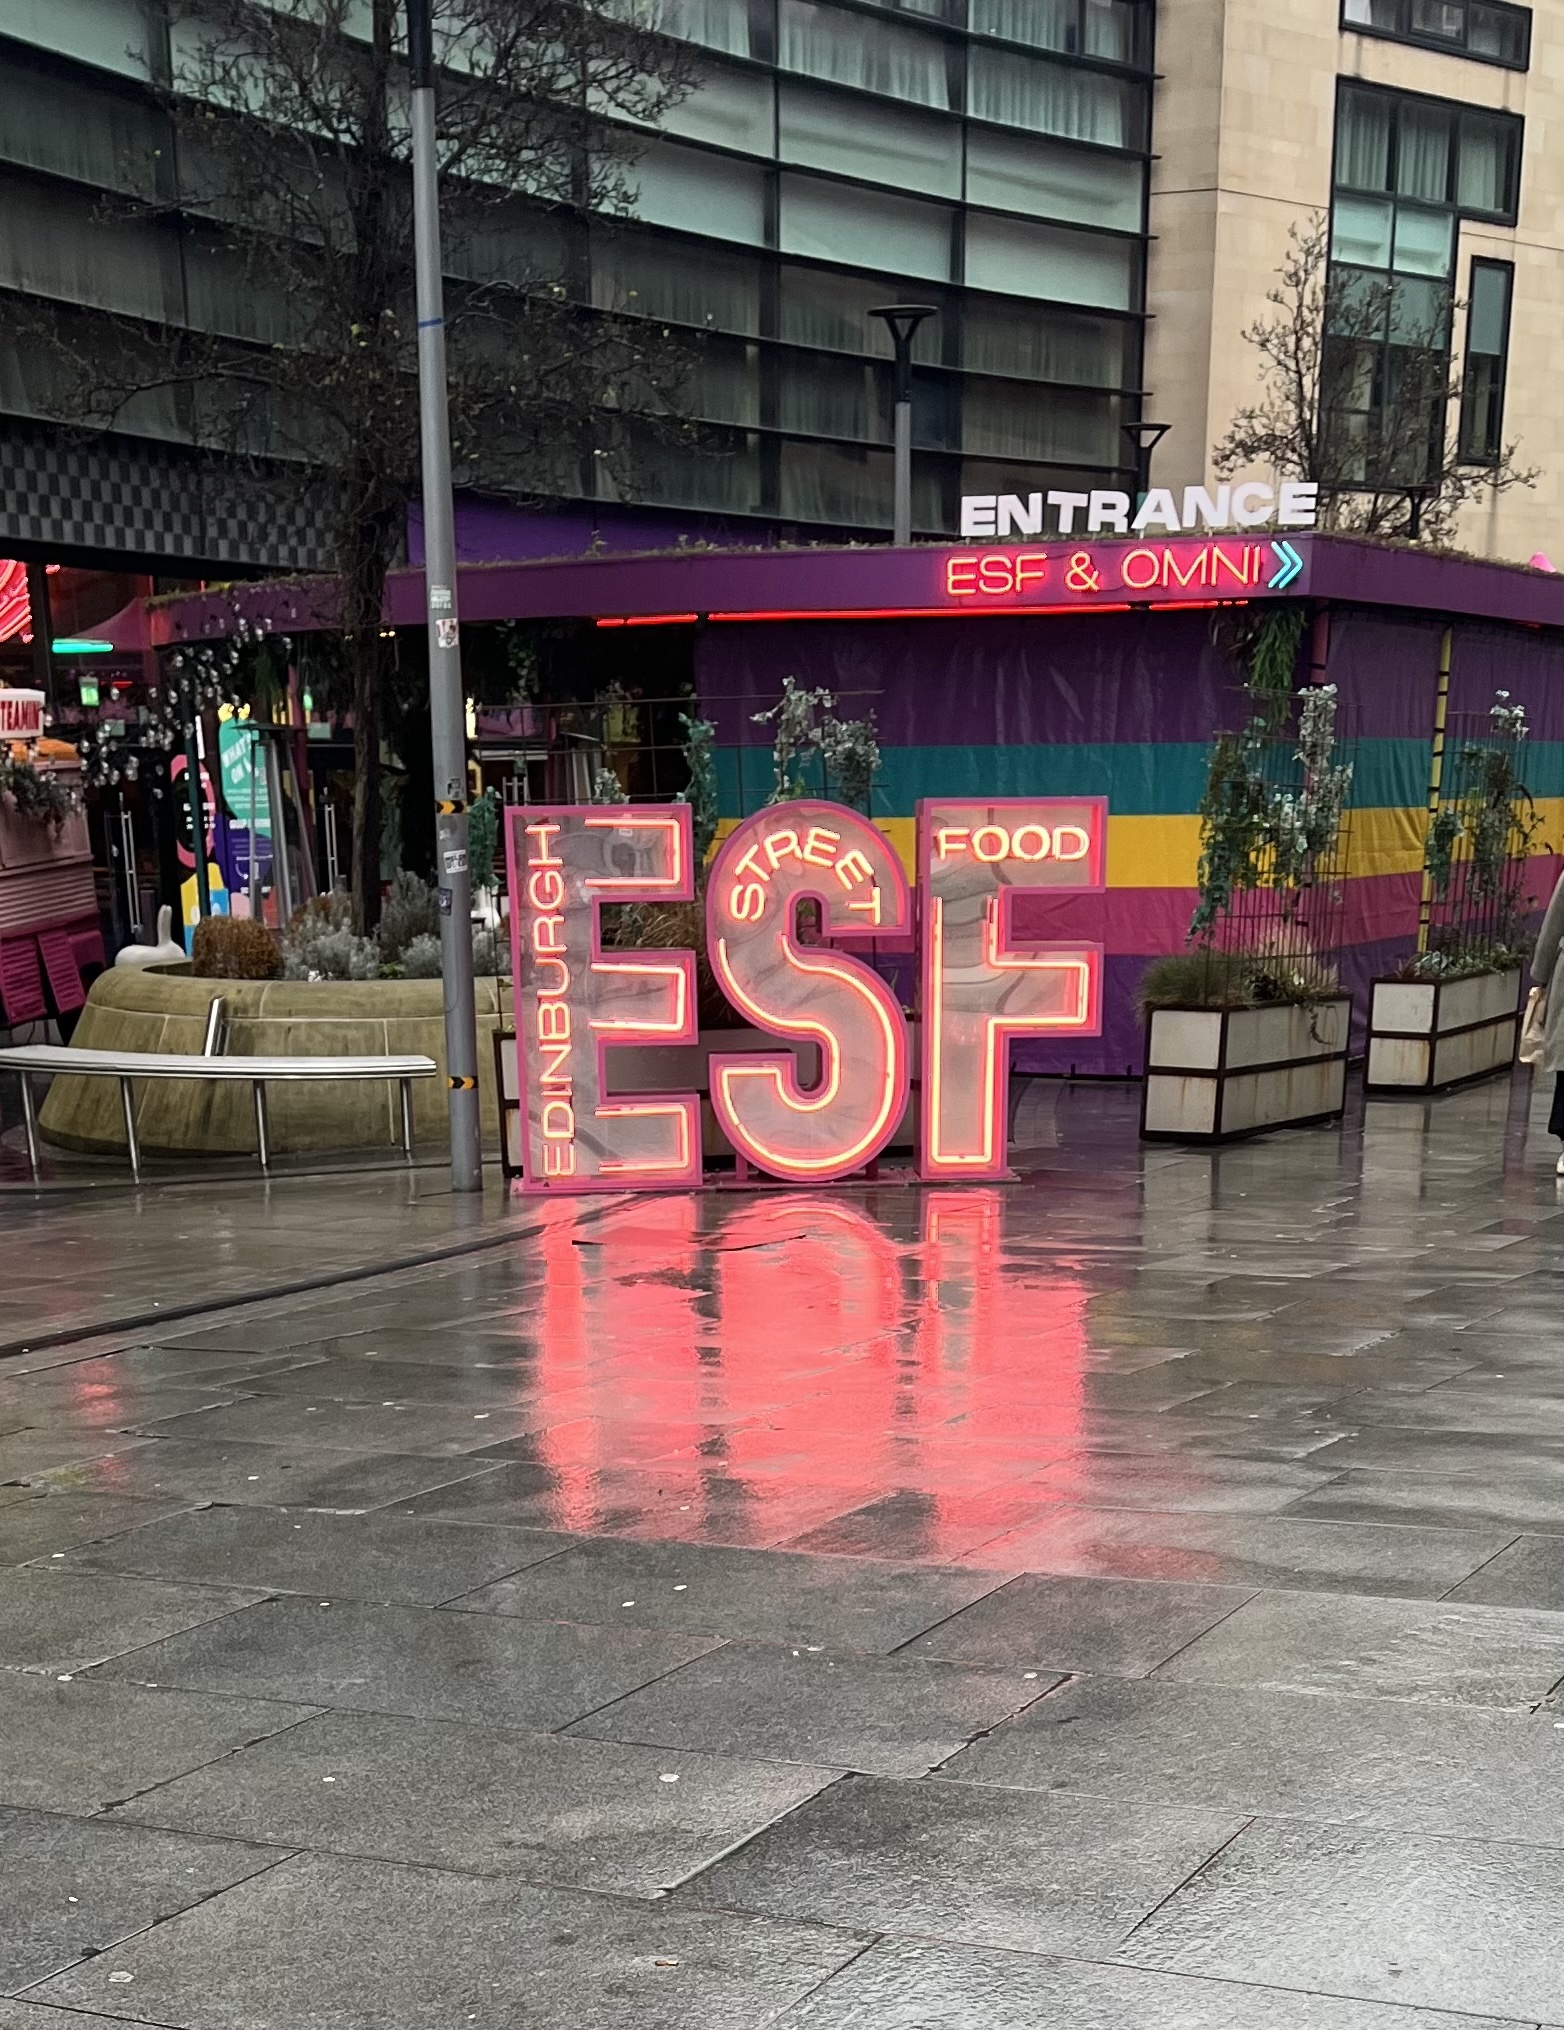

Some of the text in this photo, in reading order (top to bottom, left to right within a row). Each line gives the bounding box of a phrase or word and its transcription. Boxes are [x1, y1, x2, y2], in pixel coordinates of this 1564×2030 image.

[960, 482, 1318, 537] ENTRANCE
[946, 545, 1261, 595] ESF & OMNI
[937, 824, 1091, 862] FOOD
[730, 827, 881, 926] STREET
[524, 823, 577, 1180] EDINBURGH
